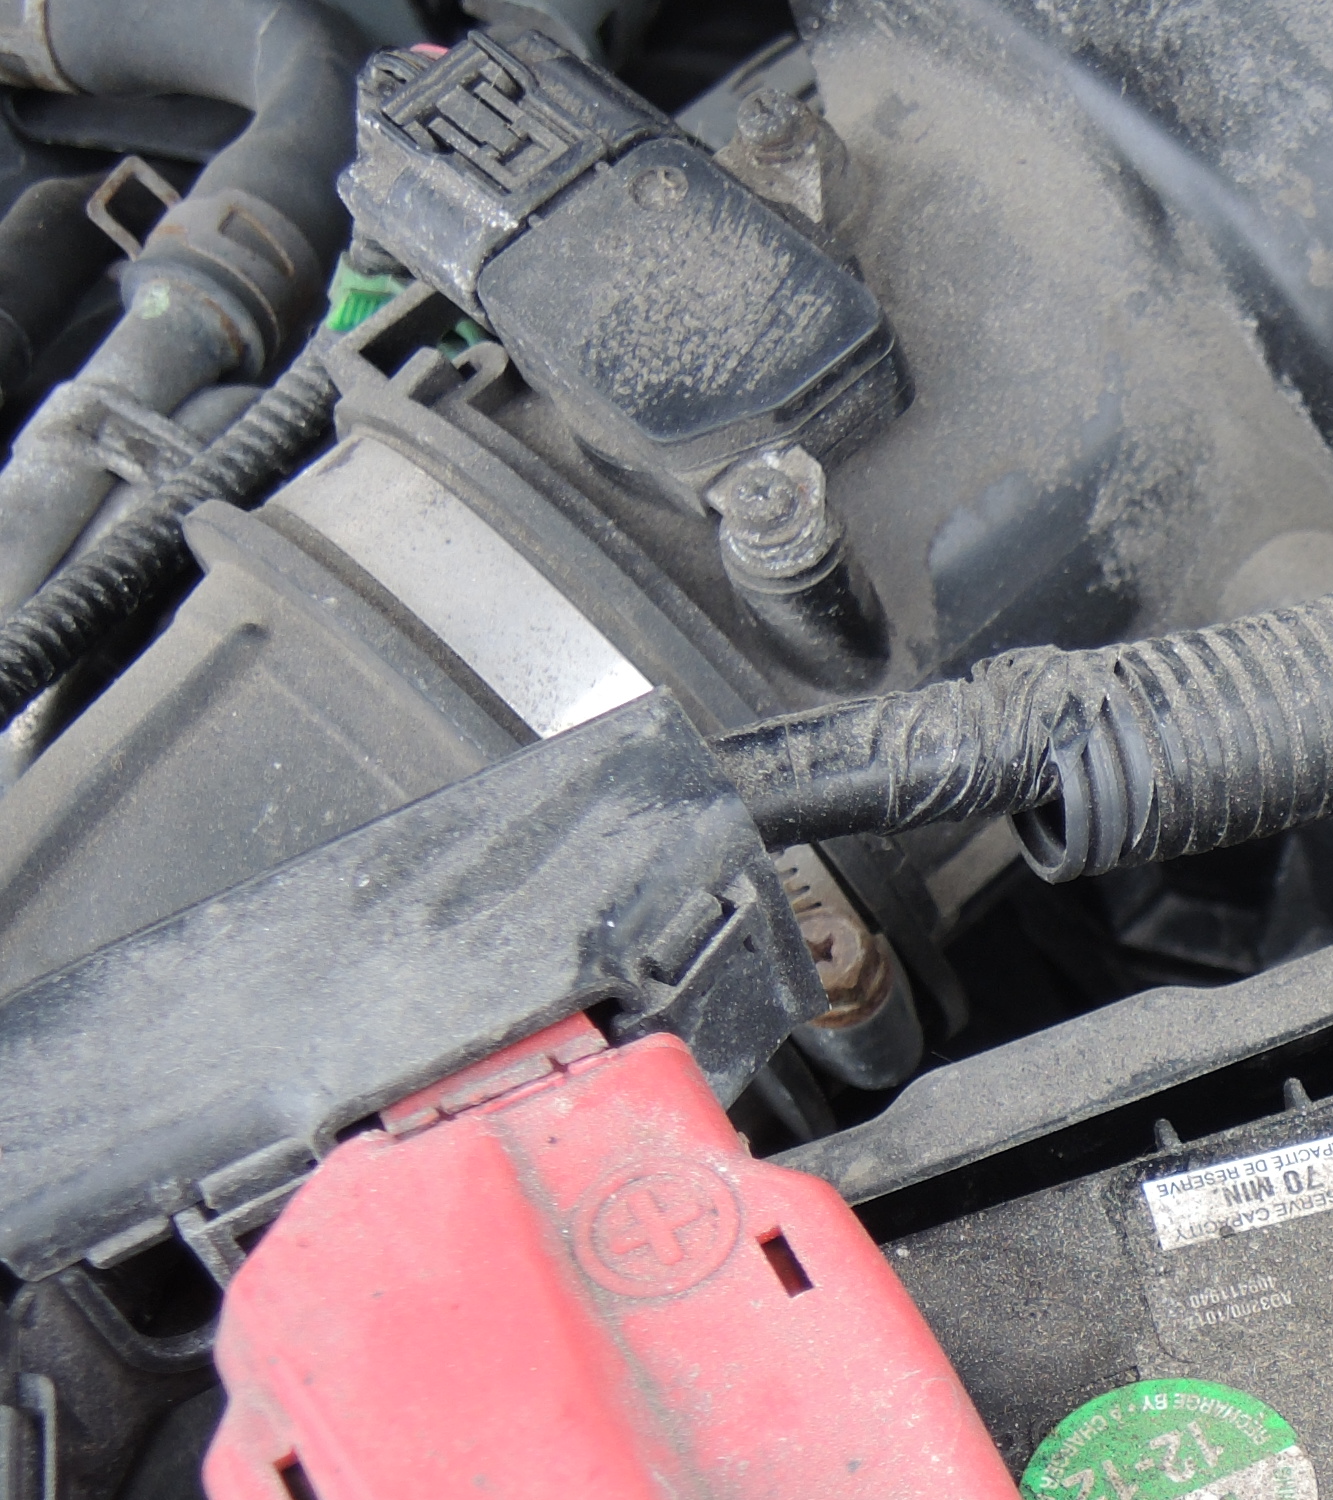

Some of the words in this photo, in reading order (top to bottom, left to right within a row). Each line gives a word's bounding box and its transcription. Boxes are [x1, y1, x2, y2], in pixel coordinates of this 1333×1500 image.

[1242, 1159, 1267, 1175] DE
[1281, 1164, 1324, 1196] 70
[1174, 1206, 1270, 1241] CAPACITY
[1141, 1392, 1167, 1410] BY
